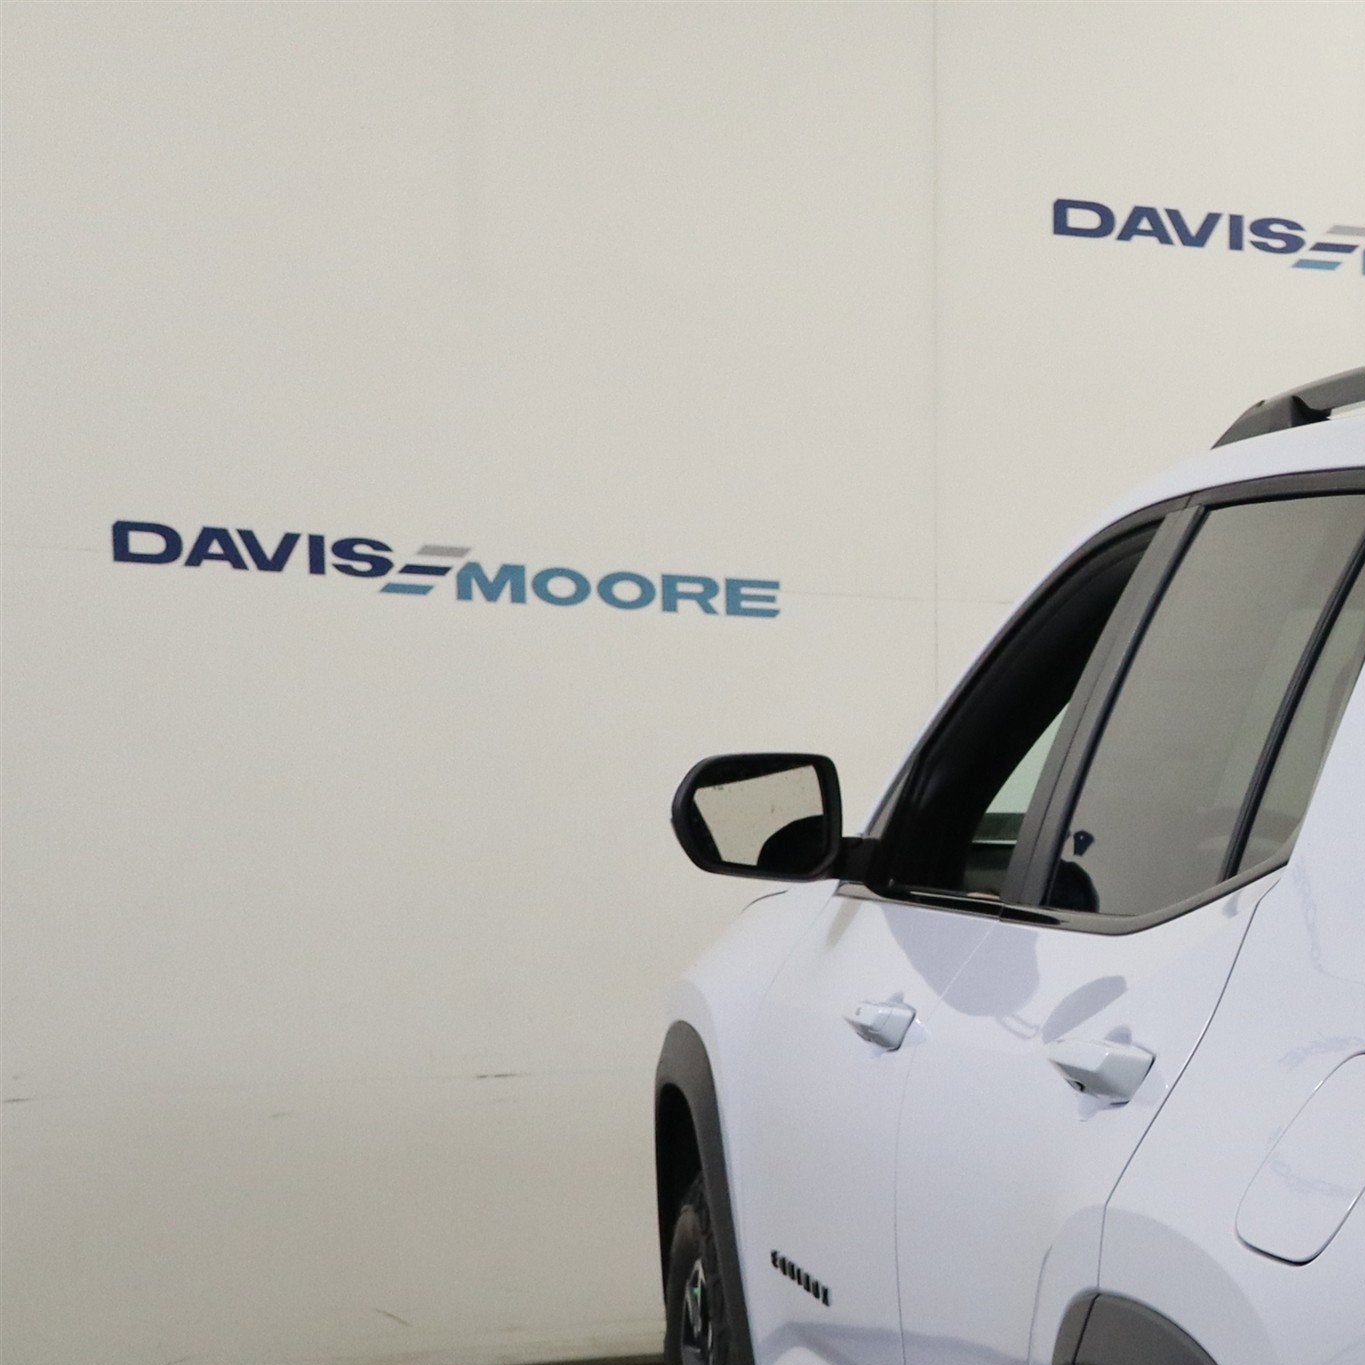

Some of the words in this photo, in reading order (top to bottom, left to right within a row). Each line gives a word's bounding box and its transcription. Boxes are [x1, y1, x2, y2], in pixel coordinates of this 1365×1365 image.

[1052, 198, 1307, 255] DAVIS
[110, 520, 394, 578] DAVIS
[455, 561, 782, 618] MOORE
